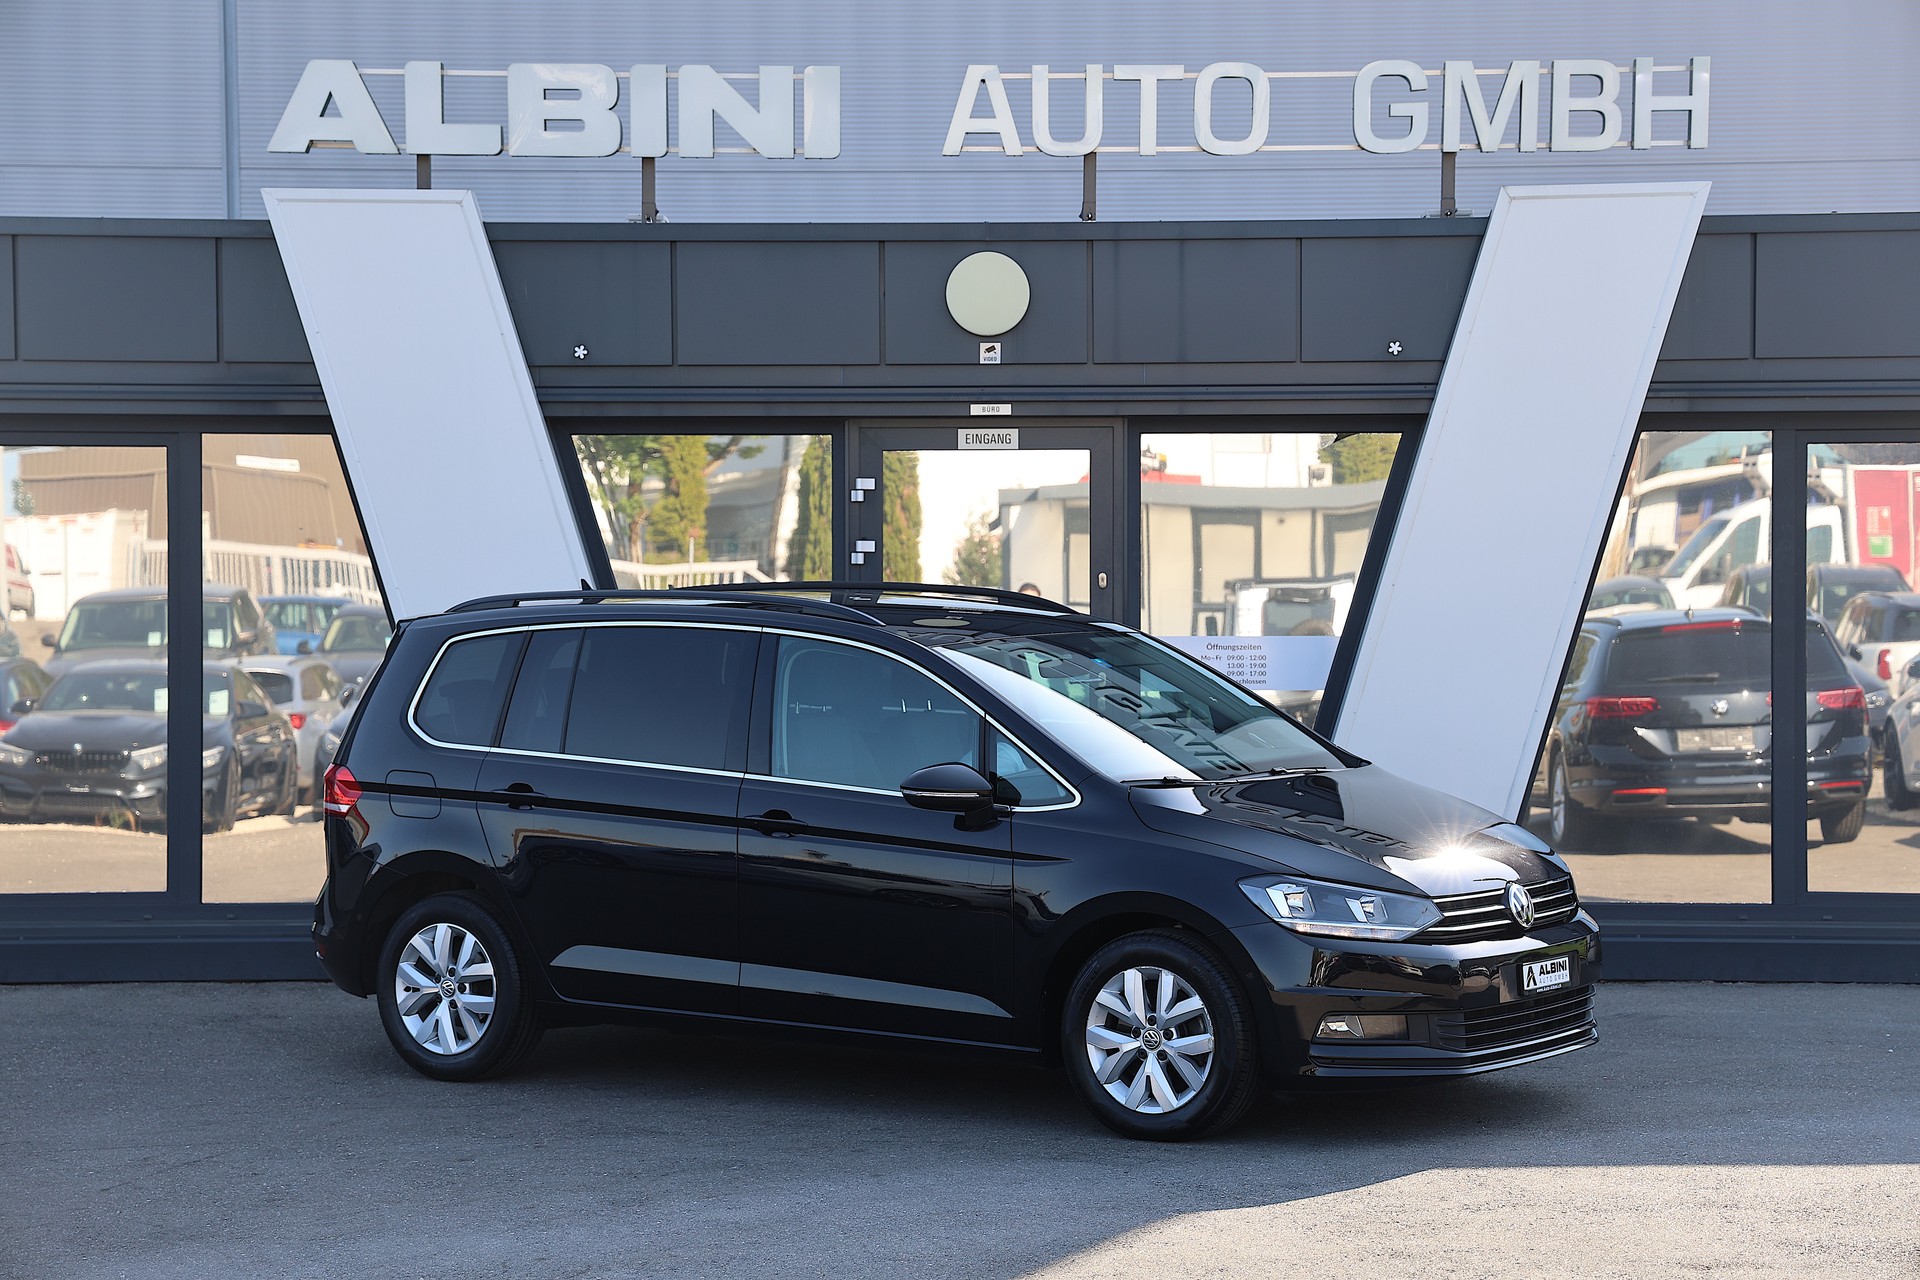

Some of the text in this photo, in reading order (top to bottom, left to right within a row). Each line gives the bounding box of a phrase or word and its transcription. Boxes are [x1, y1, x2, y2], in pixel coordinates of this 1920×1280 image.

[266, 55, 1711, 159] ALBINI AUTO GMBH
[965, 433, 1012, 445] EINGANG
[1206, 642, 1262, 652] Öffnungszeiten
[1538, 959, 1567, 976] ALBINI
